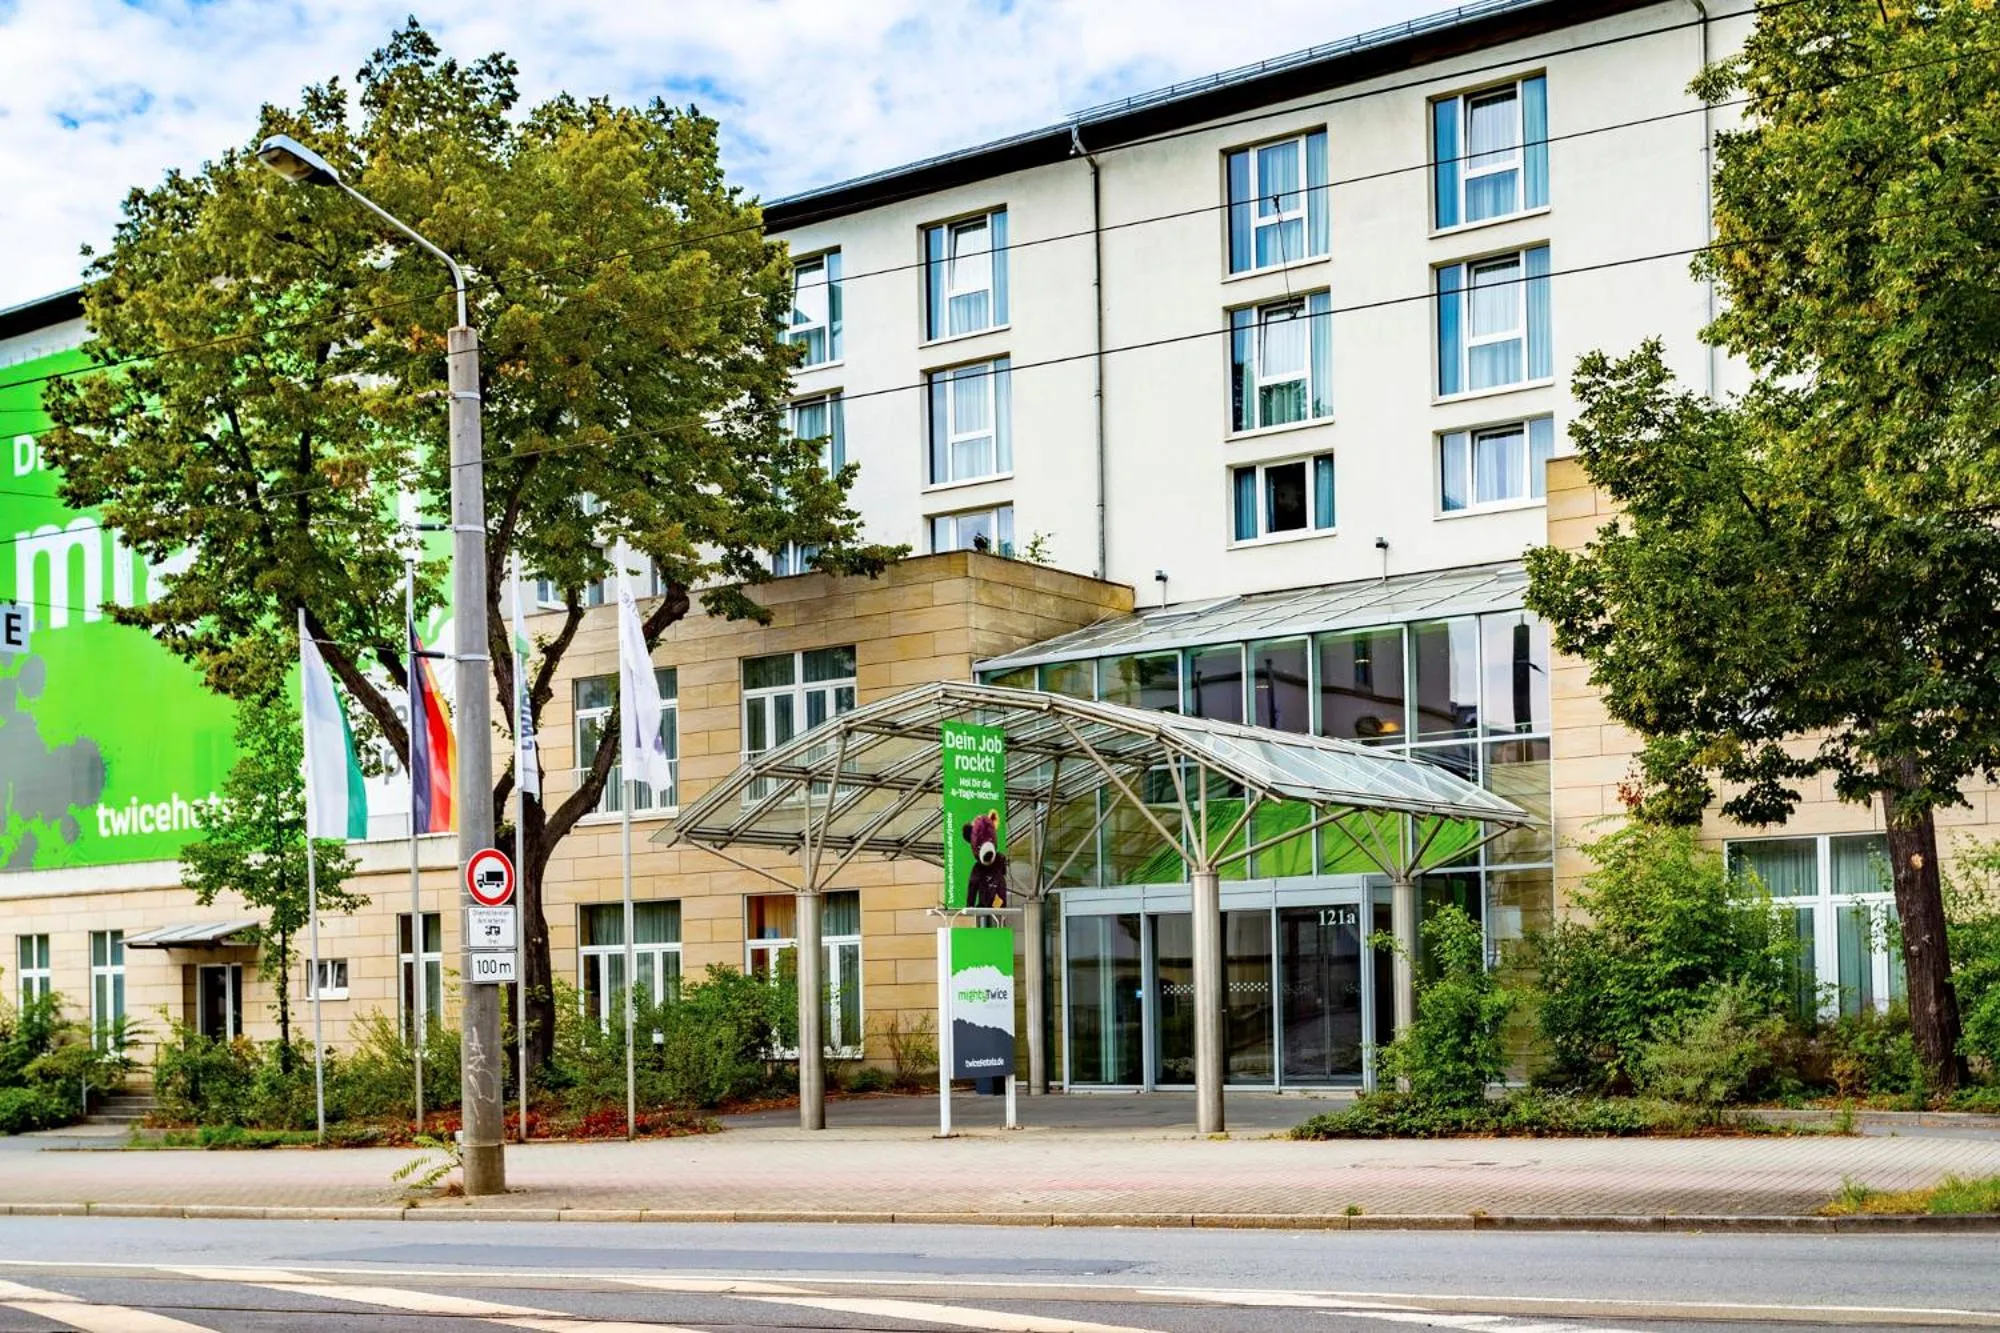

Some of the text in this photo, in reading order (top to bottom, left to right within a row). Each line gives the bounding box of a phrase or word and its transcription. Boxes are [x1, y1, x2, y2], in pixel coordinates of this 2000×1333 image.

[5, 612, 22, 646] E
[945, 730, 1002, 753] Dein Job
[955, 752, 995, 773] rockt!
[1319, 909, 1356, 926] 121a
[477, 959, 511, 974] 100 m
